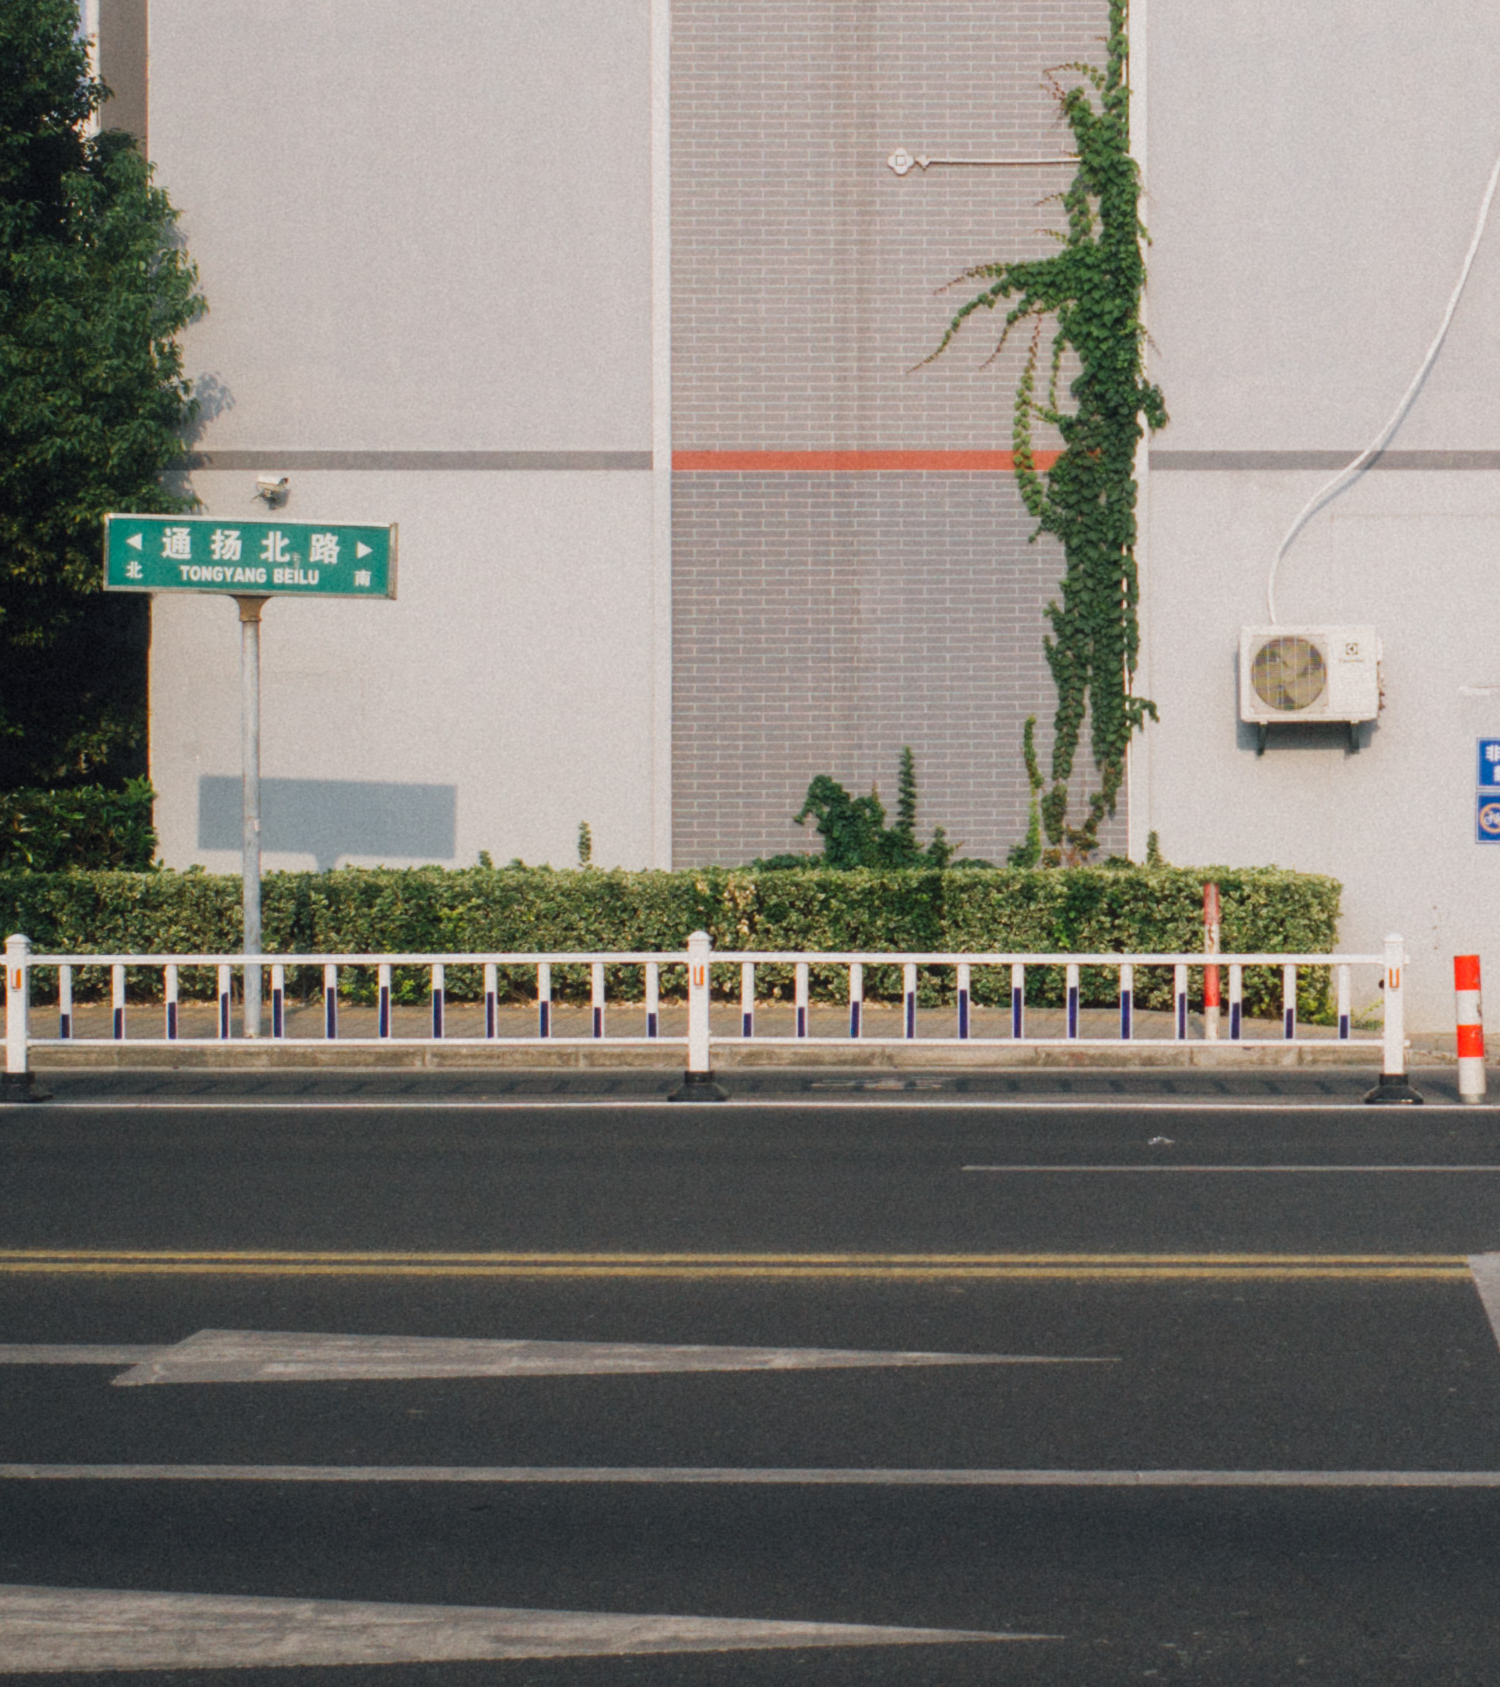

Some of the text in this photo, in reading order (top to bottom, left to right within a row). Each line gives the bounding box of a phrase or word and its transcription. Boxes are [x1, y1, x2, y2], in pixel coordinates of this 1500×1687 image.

[161, 527, 341, 564] 通扬北路
[126, 561, 143, 579] 北
[180, 566, 267, 583] TONGYANG
[354, 570, 372, 587] 南
